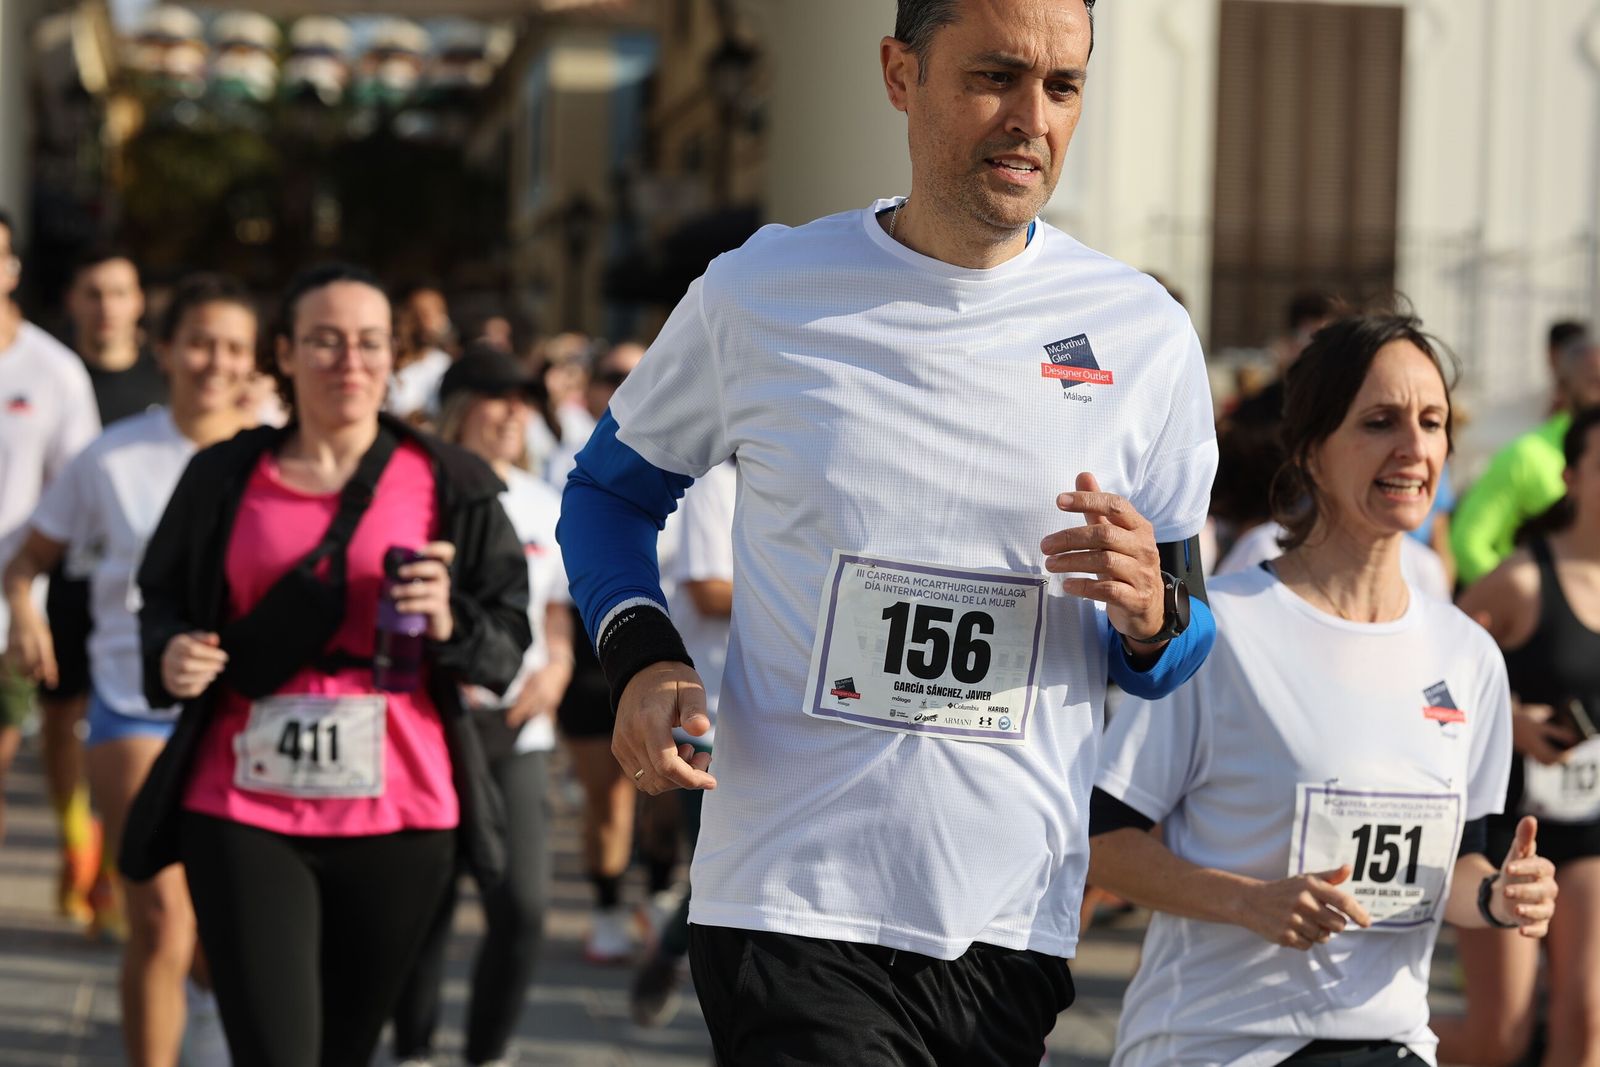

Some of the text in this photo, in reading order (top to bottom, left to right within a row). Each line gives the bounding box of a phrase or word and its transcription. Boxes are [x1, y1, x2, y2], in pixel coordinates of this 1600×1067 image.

[1046, 337, 1086, 354] McArthur
[1051, 353, 1072, 364] Glen
[1044, 365, 1110, 381] Designer Outlet
[1063, 391, 1092, 403] Málaga
[856, 569, 1027, 598] III CARRERA MCARTHURGLEN MÁLAGA
[864, 580, 1016, 608] DÍA INTERNACIONAL DE LA MUJER
[881, 601, 995, 684] 156
[893, 681, 992, 701] GARCÍA SÁNCHEZ, JAVIER
[953, 702, 980, 712] Columbia
[987, 706, 1009, 714] HARIBO
[944, 717, 972, 727] ARMANI
[276, 721, 338, 762] 411
[1351, 823, 1423, 884] 151
